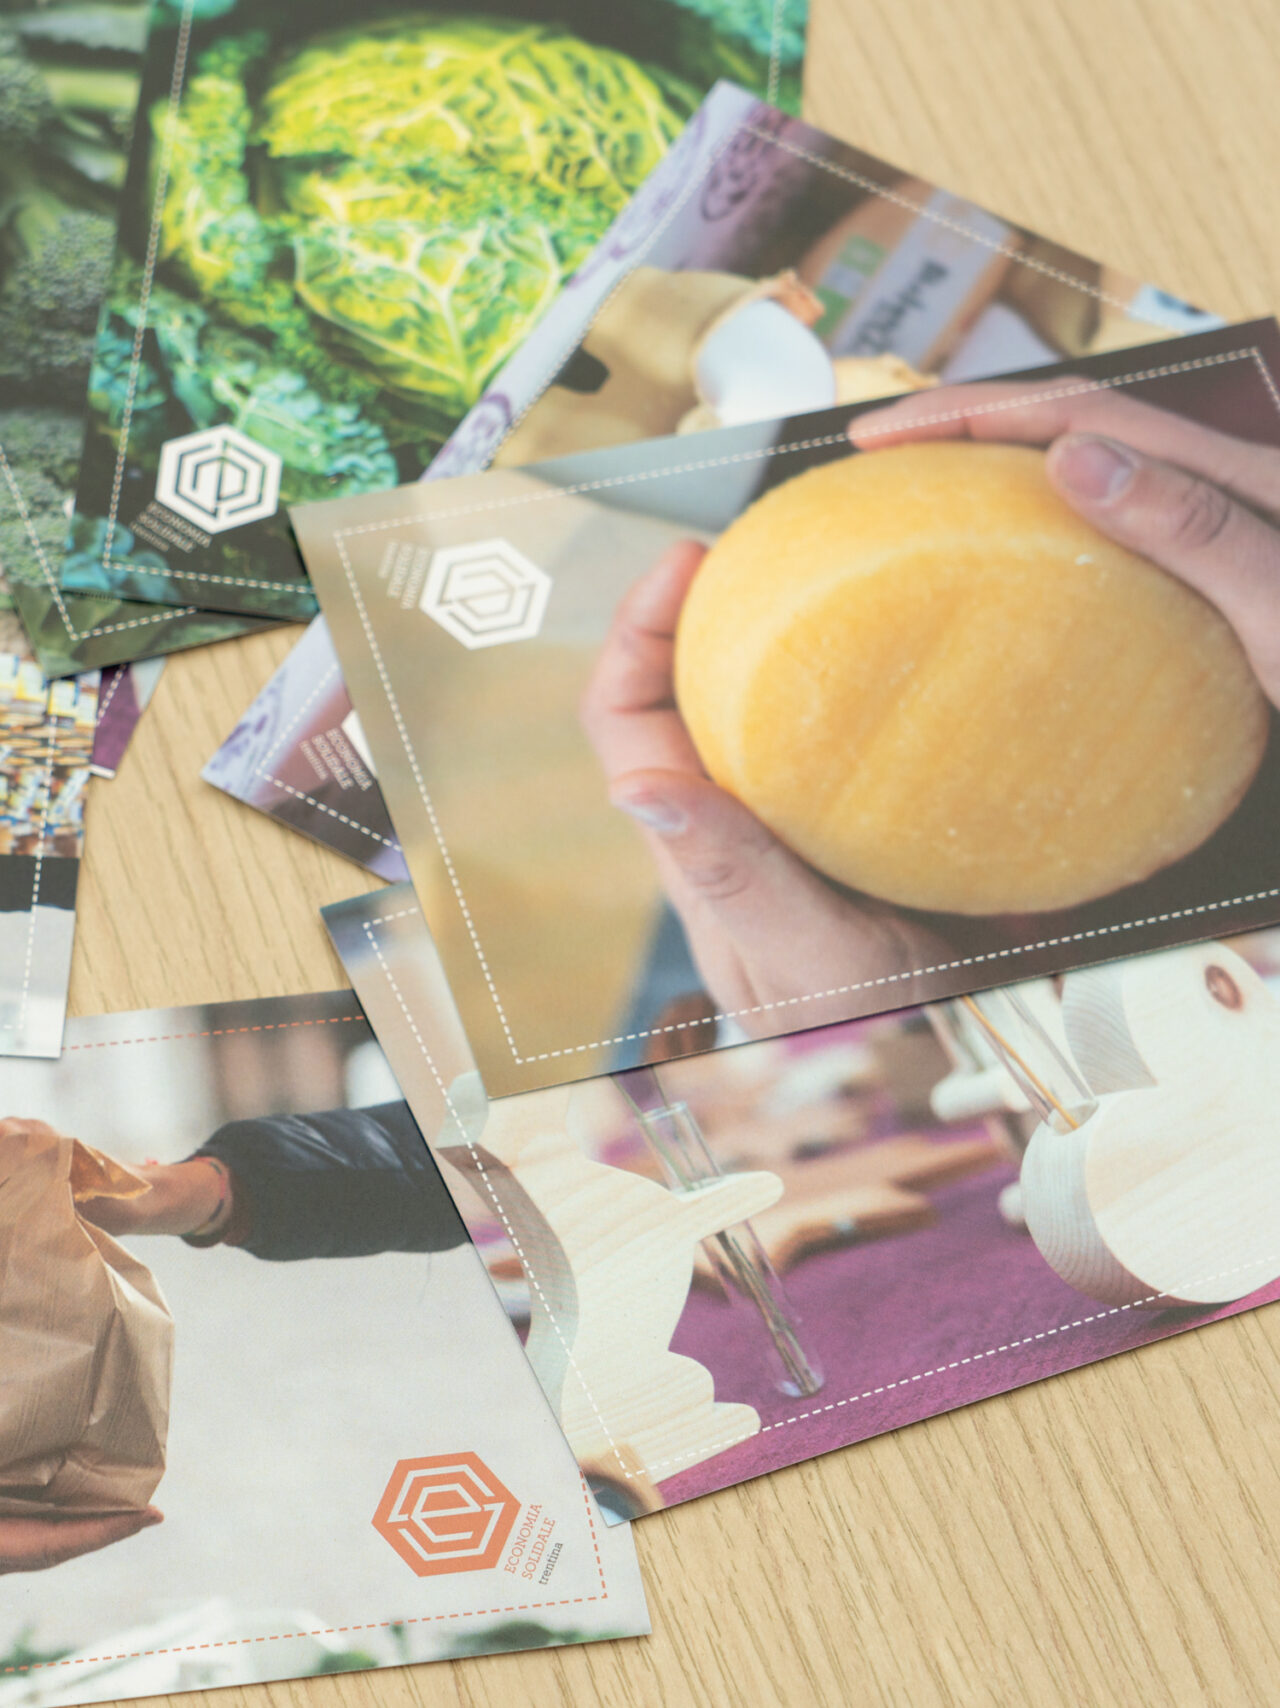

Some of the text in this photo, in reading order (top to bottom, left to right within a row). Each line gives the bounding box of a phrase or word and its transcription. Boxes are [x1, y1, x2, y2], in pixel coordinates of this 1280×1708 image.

[503, 1503, 543, 1575] ECONOMIA
[521, 1516, 556, 1581] SOLIDALE
[538, 1542, 564, 1586] trentina
